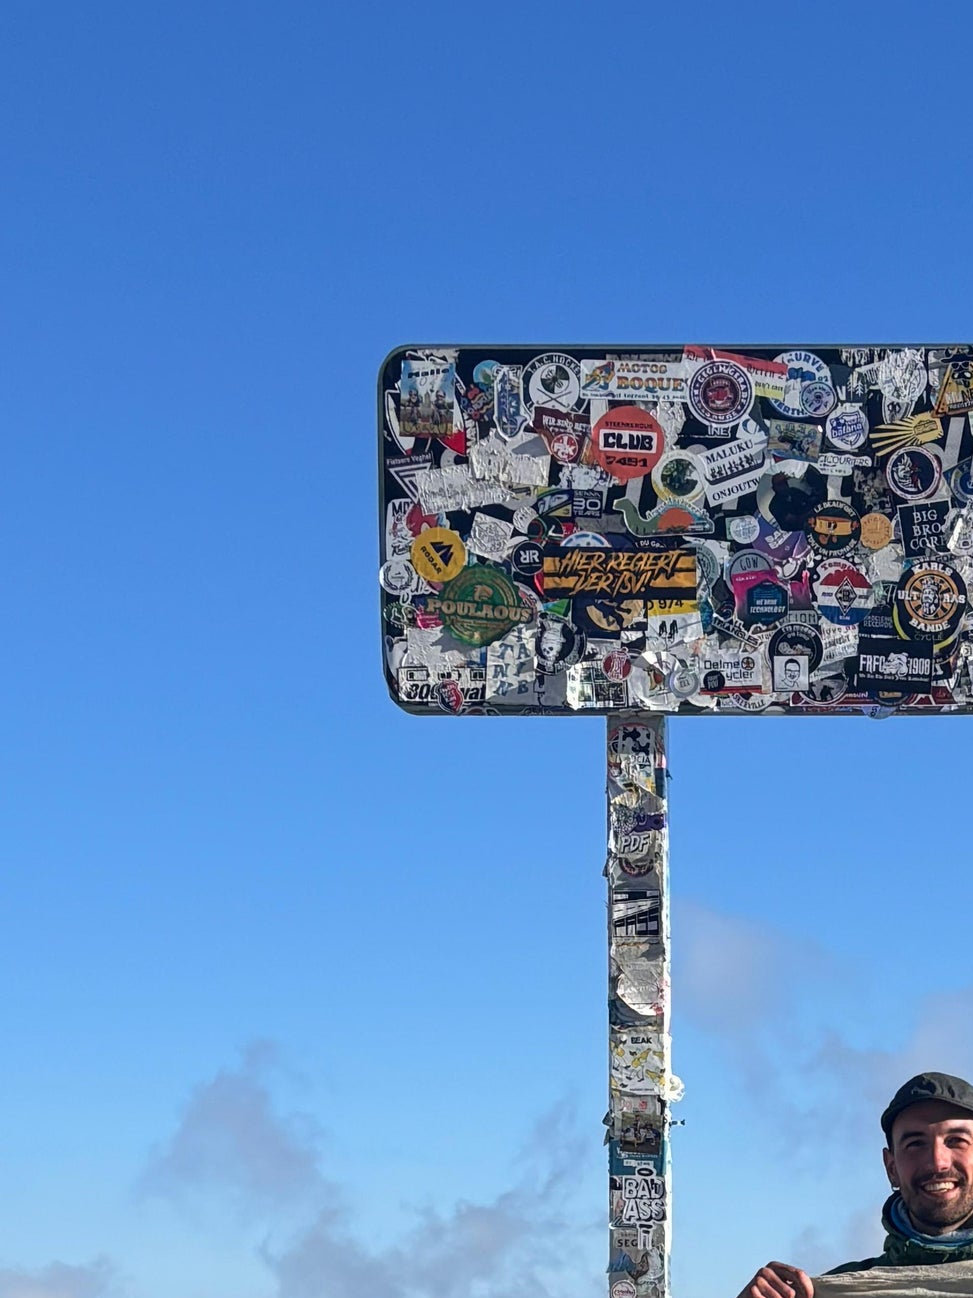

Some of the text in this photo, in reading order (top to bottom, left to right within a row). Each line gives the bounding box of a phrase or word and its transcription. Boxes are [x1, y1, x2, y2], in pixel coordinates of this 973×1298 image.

[616, 375, 688, 394] BOQUE
[603, 432, 653, 451] CLUB
[605, 455, 648, 468] 7491
[705, 440, 754, 464] MALUKU
[573, 499, 601, 511] 30
[913, 509, 937, 524] BIG
[420, 545, 443, 576] RODAR
[911, 562, 954, 577] KARLS
[908, 618, 951, 633] BANDE
[704, 659, 741, 670] Delme
[907, 657, 932, 676] 1908
[620, 834, 651, 853] PDF
[630, 1036, 654, 1045] BEAK
[624, 1179, 664, 1200] BAD
[623, 1199, 665, 1222] ASS
